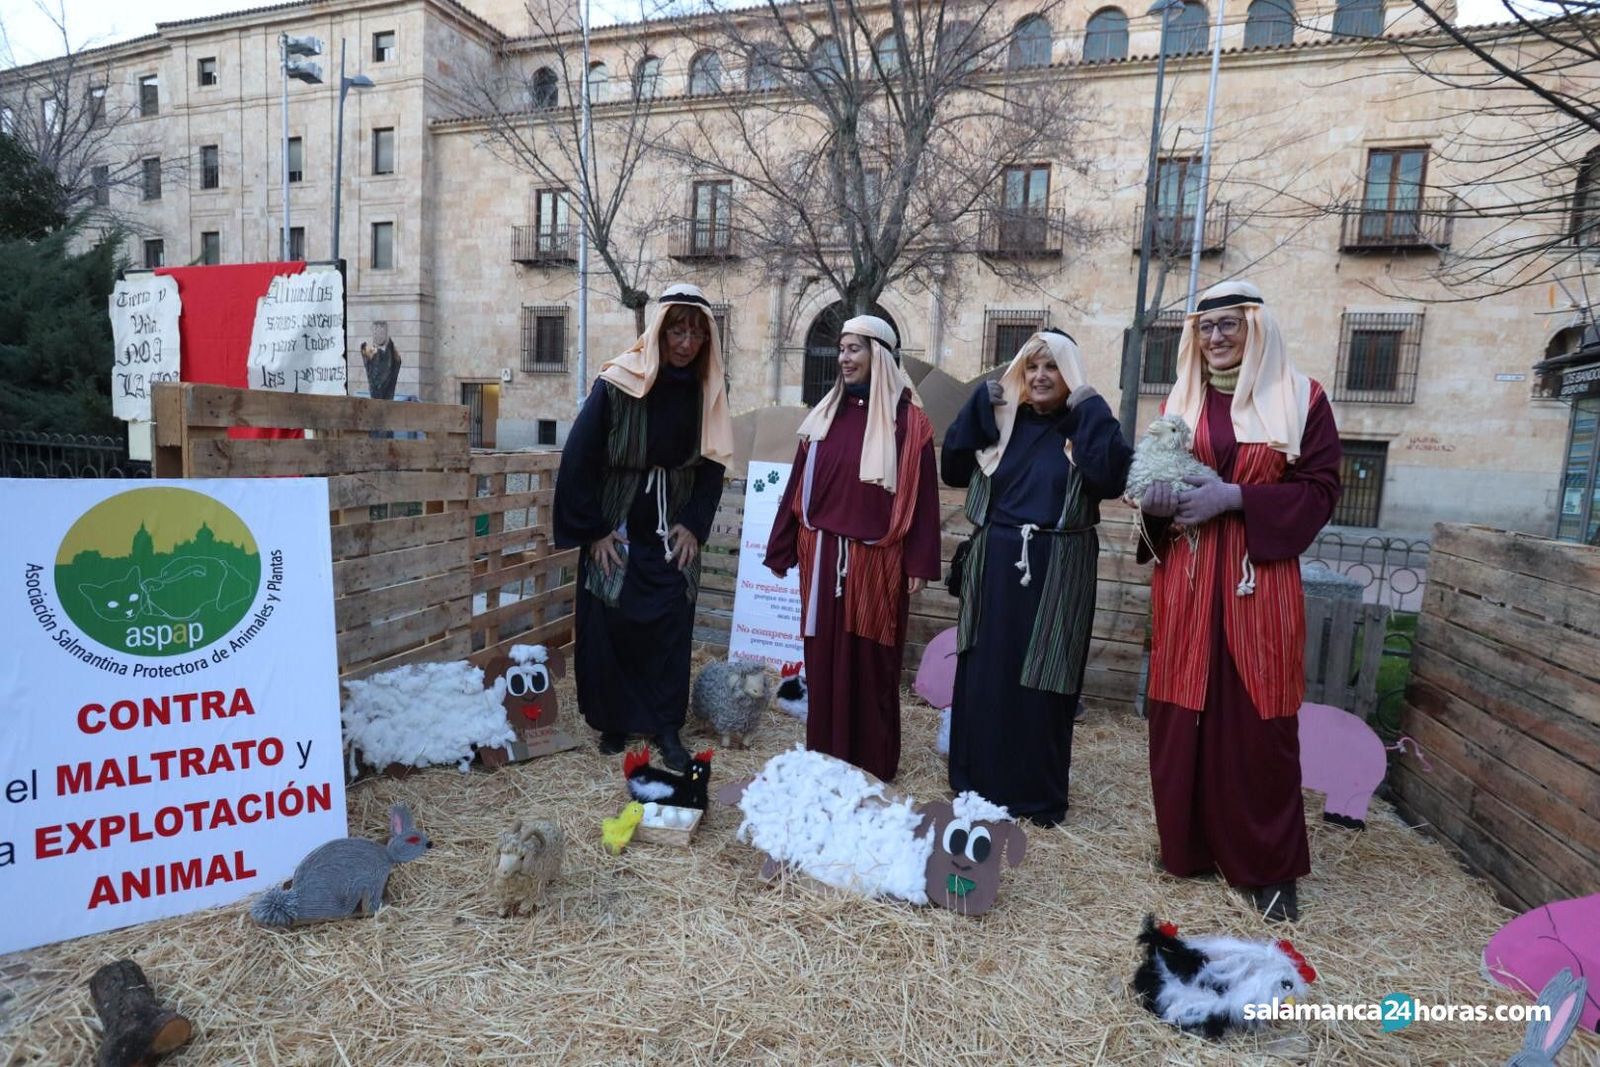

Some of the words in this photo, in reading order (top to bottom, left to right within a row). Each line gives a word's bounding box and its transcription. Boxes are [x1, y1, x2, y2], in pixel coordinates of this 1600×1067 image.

[261, 364, 286, 389] las
[267, 549, 284, 592] Plantas
[25, 562, 58, 632] Asociación
[266, 593, 282, 602] y
[125, 622, 204, 651] aspap
[228, 602, 275, 653] Animales
[736, 623, 750, 633] No
[751, 627, 793, 640] compres
[51, 628, 129, 676] Salmantina
[132, 658, 209, 679] Protectora
[211, 649, 231, 664] de
[77, 687, 255, 735] CONTRA
[5, 769, 38, 804] el
[56, 737, 284, 797] MALTRATO
[297, 739, 313, 769] y
[35, 781, 332, 860] EXPLOTACIÓN
[87, 850, 257, 910] ANIMAL
